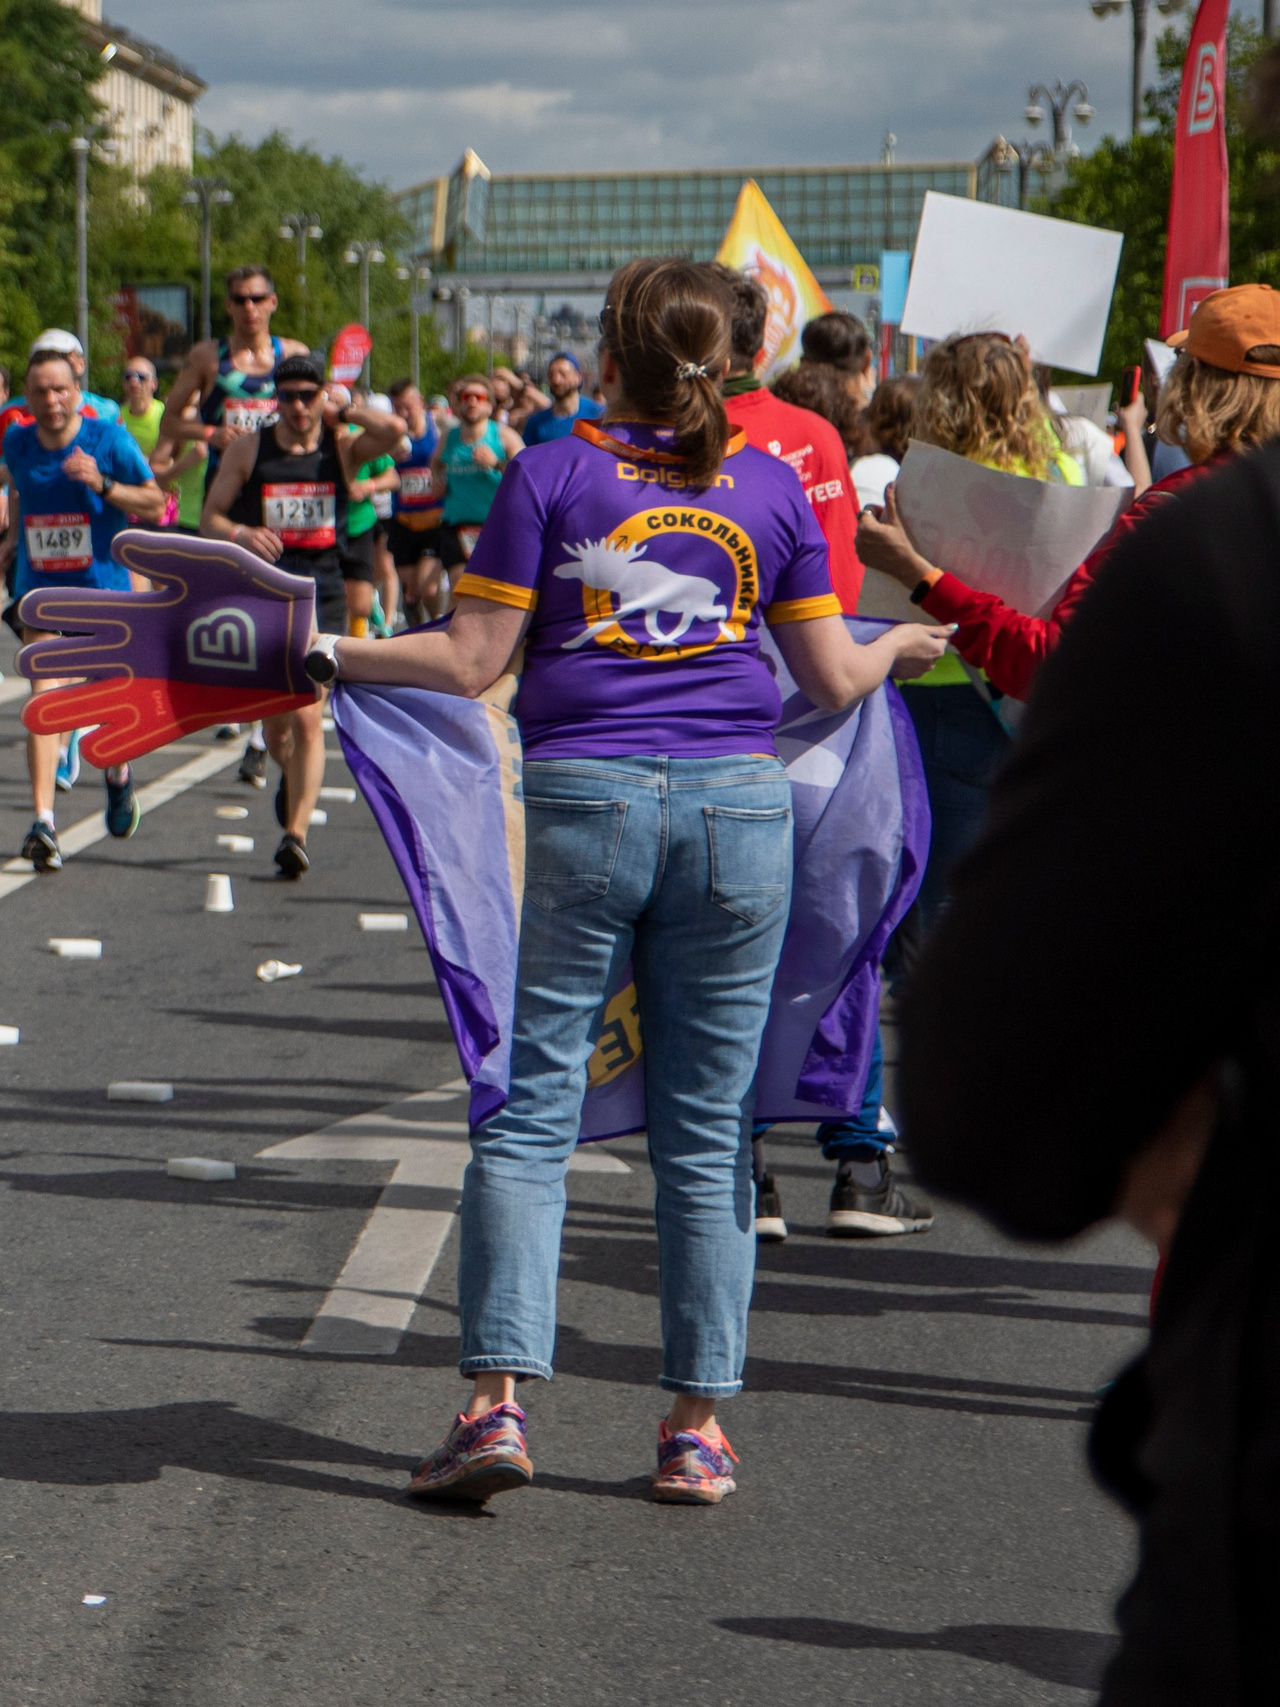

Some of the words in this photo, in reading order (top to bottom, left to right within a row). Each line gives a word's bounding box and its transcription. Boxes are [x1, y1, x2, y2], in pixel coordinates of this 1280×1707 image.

[276, 500, 324, 520] 1251
[35, 529, 83, 549] 1489
[646, 512, 755, 611] СОКОЛЬНИКИ
